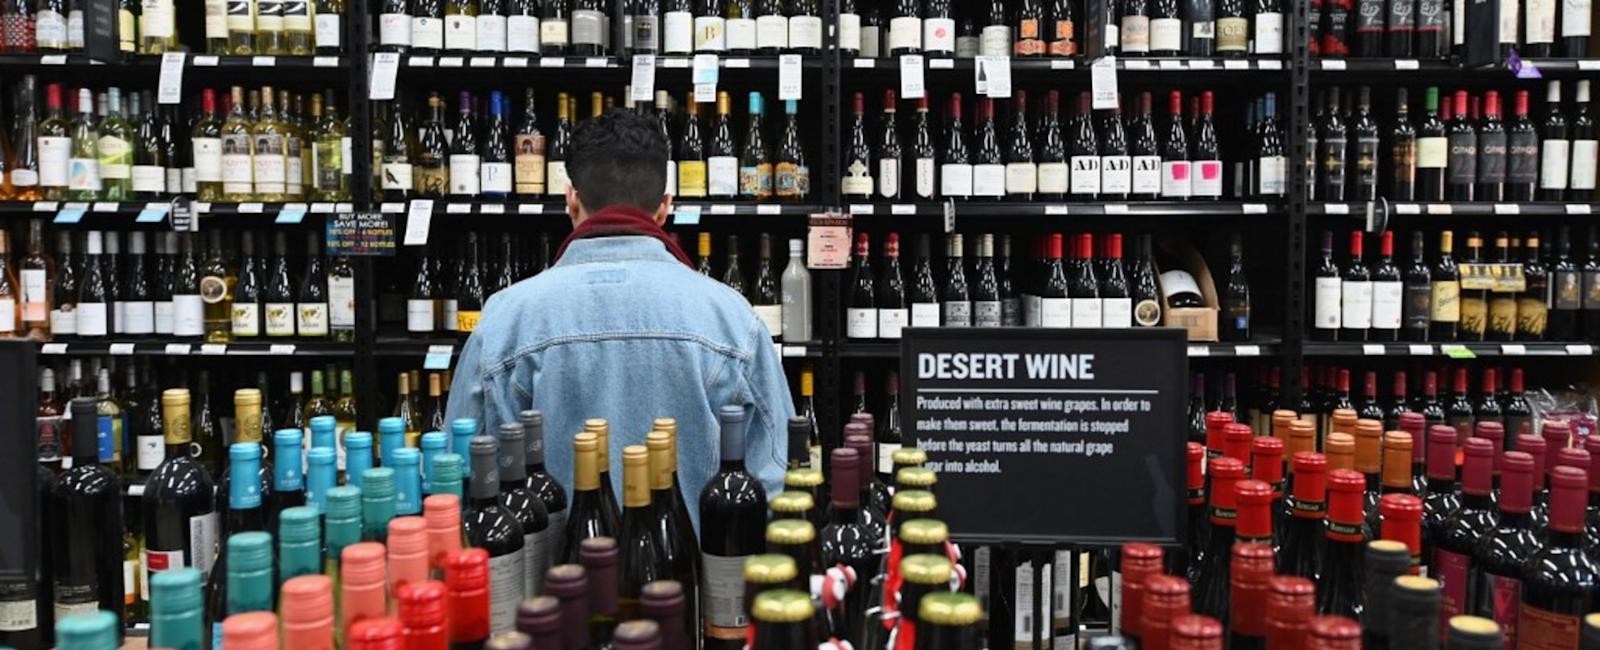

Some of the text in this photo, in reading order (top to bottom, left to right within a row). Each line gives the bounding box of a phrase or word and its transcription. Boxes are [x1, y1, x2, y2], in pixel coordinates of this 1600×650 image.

[334, 220, 388, 228] SAVE MORE!
[918, 353, 1095, 380] DESERT WINE
[917, 396, 1151, 413] Produced with extra sweet wine grapes. In order to
[917, 417, 1129, 434] make them sweet, the fermentation is stopped
[917, 438, 1113, 456] before the yeast turns all the natural grape
[945, 459, 964, 473] into
[965, 459, 1001, 473] alcohol.
